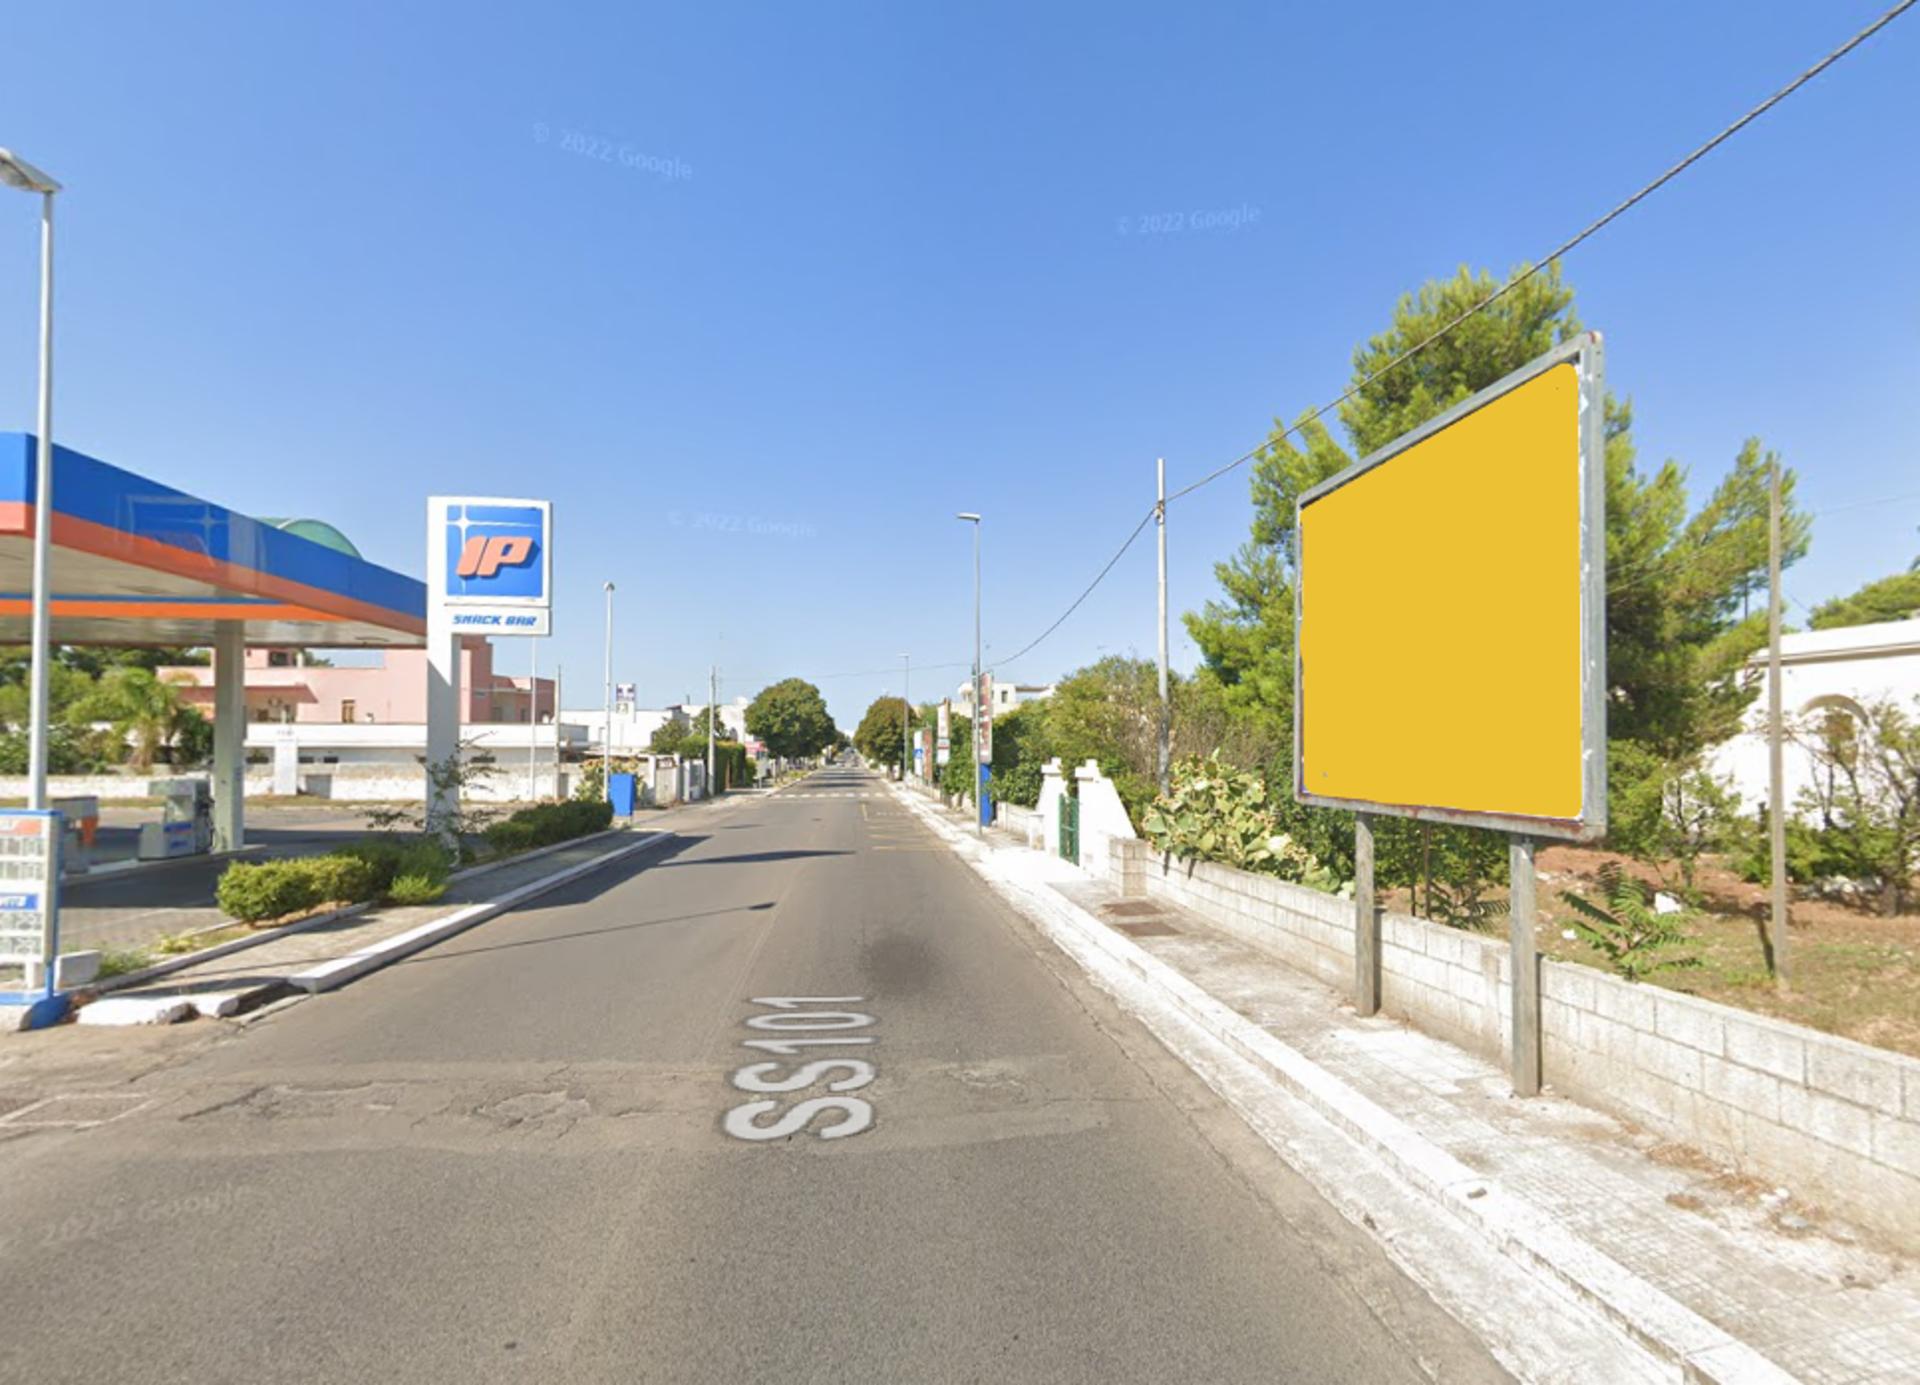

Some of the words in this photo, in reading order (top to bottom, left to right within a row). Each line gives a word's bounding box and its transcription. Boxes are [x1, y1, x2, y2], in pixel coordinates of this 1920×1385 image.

[455, 535, 534, 578] IP
[505, 615, 537, 627] BAR
[724, 995, 877, 1141] SS101
